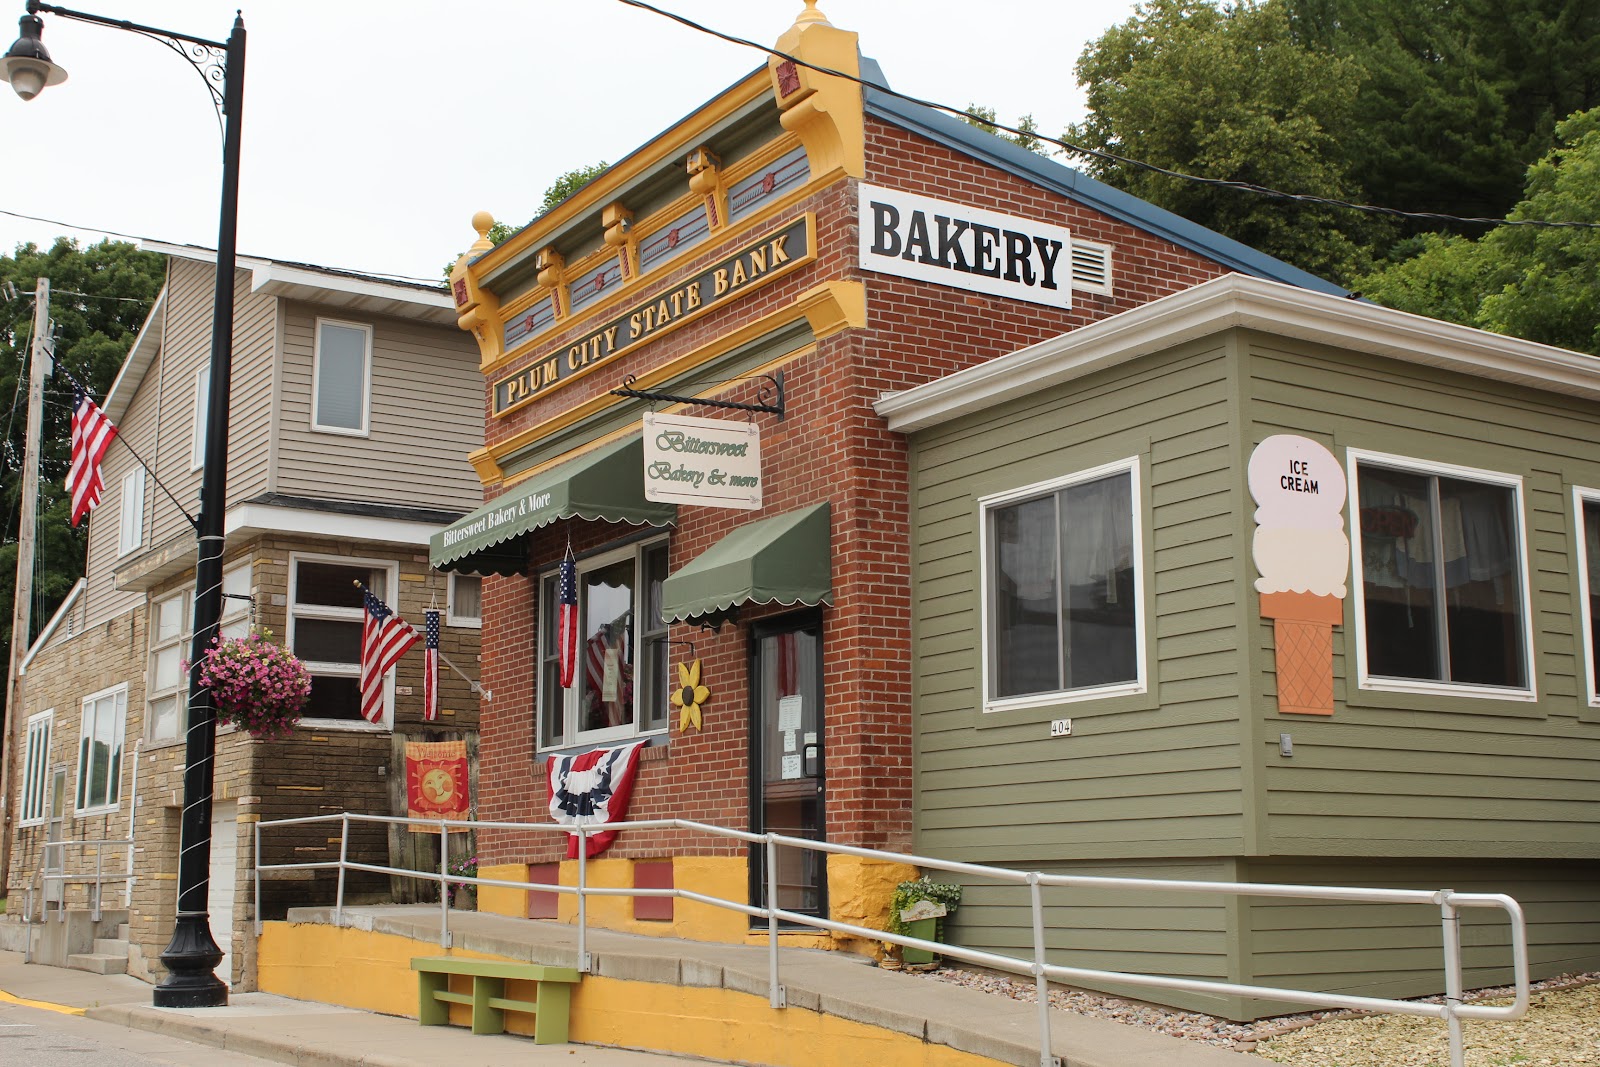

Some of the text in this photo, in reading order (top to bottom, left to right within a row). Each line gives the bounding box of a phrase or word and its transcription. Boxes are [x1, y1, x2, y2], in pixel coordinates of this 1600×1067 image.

[870, 200, 1063, 290] BAKERY
[507, 234, 791, 404] PLUM CITY STATE BANK
[655, 430, 749, 457] Bittersweet
[647, 460, 759, 489] Bakery & more
[1289, 459, 1309, 476] ICE
[1280, 475, 1319, 495] CREAM
[443, 492, 551, 548] Bittersweet Bakery & More
[1052, 720, 1070, 734] 404
